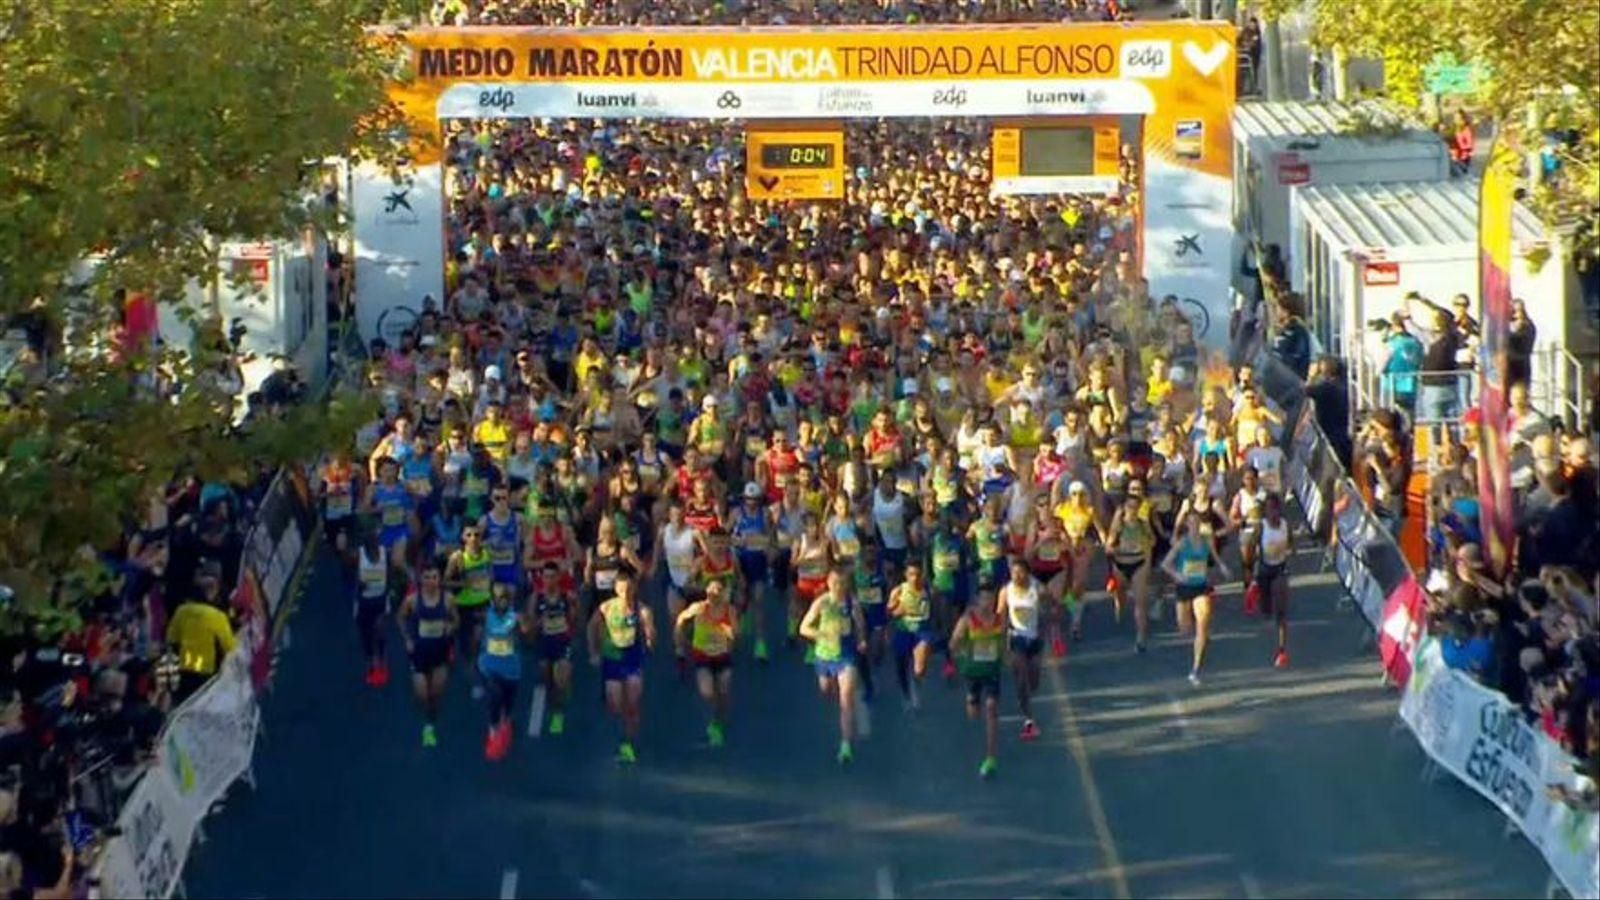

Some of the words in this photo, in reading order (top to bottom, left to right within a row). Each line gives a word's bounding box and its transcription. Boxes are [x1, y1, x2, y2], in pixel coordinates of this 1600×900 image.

[419, 48, 515, 76] MEDIO
[528, 40, 683, 77] MARATÓN
[689, 47, 838, 79] VALENCIA
[837, 45, 973, 76] TRINIDAD
[976, 43, 1114, 75] ALFONSO
[1126, 48, 1164, 69] edp
[478, 86, 515, 112] edp
[576, 92, 637, 107] luanvi
[932, 84, 968, 109] edp
[1026, 88, 1086, 104] luanvi
[790, 148, 826, 163] 0:04
